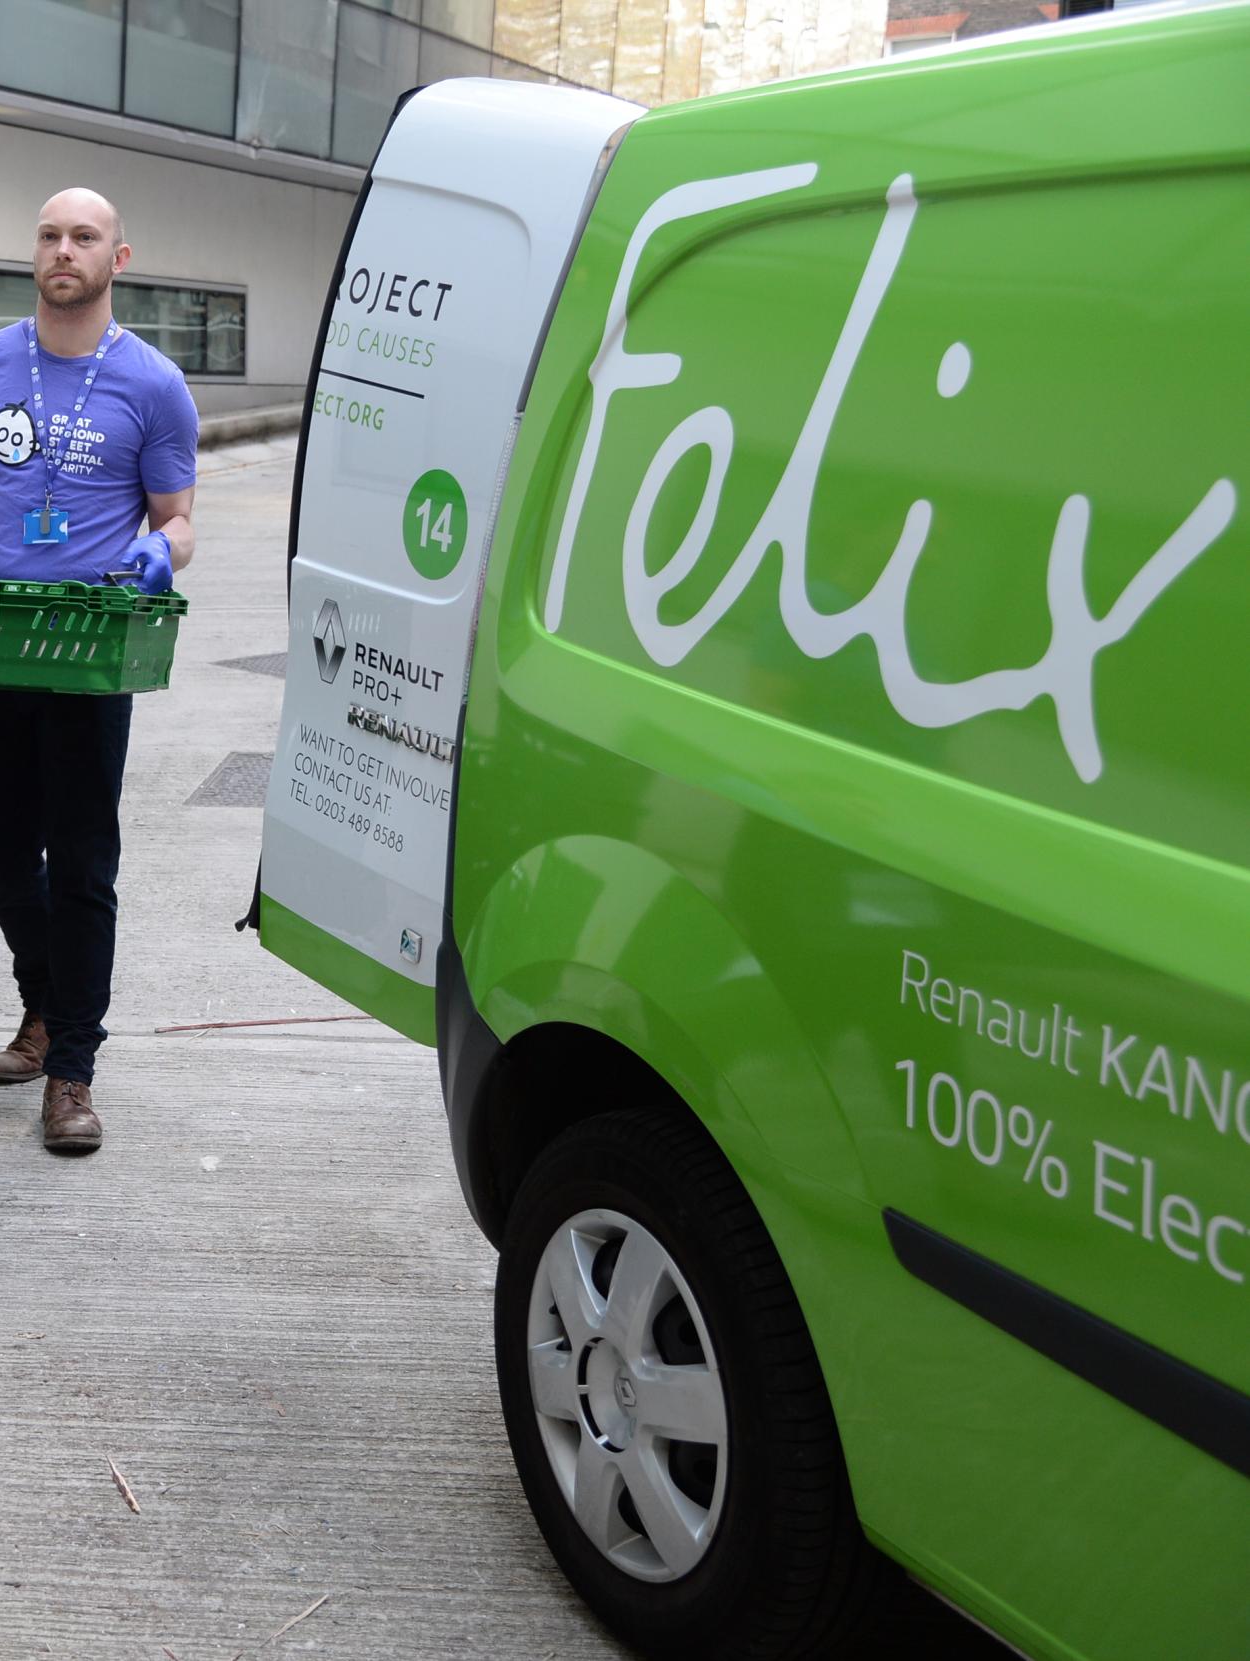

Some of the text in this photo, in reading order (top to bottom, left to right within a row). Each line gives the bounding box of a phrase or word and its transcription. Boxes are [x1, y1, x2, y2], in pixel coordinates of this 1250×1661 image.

[357, 327, 436, 368] CAUSES
[48, 437, 92, 452] STEET
[51, 414, 92, 428] GRAT
[47, 448, 104, 466] HSPITAL
[545, 162, 1235, 783] Felix
[416, 498, 453, 552] 14
[352, 670, 402, 706] PRO+
[355, 642, 444, 692] RENAULT
[348, 703, 455, 764] RENAULT
[294, 752, 393, 817] CONTACT US AT:
[300, 724, 451, 812] WANT TO GET INVOLVE
[290, 779, 405, 853] TEL: 0203 489 8588
[900, 948, 1083, 1076] Renault
[894, 1059, 1250, 1283] 100% Elec
